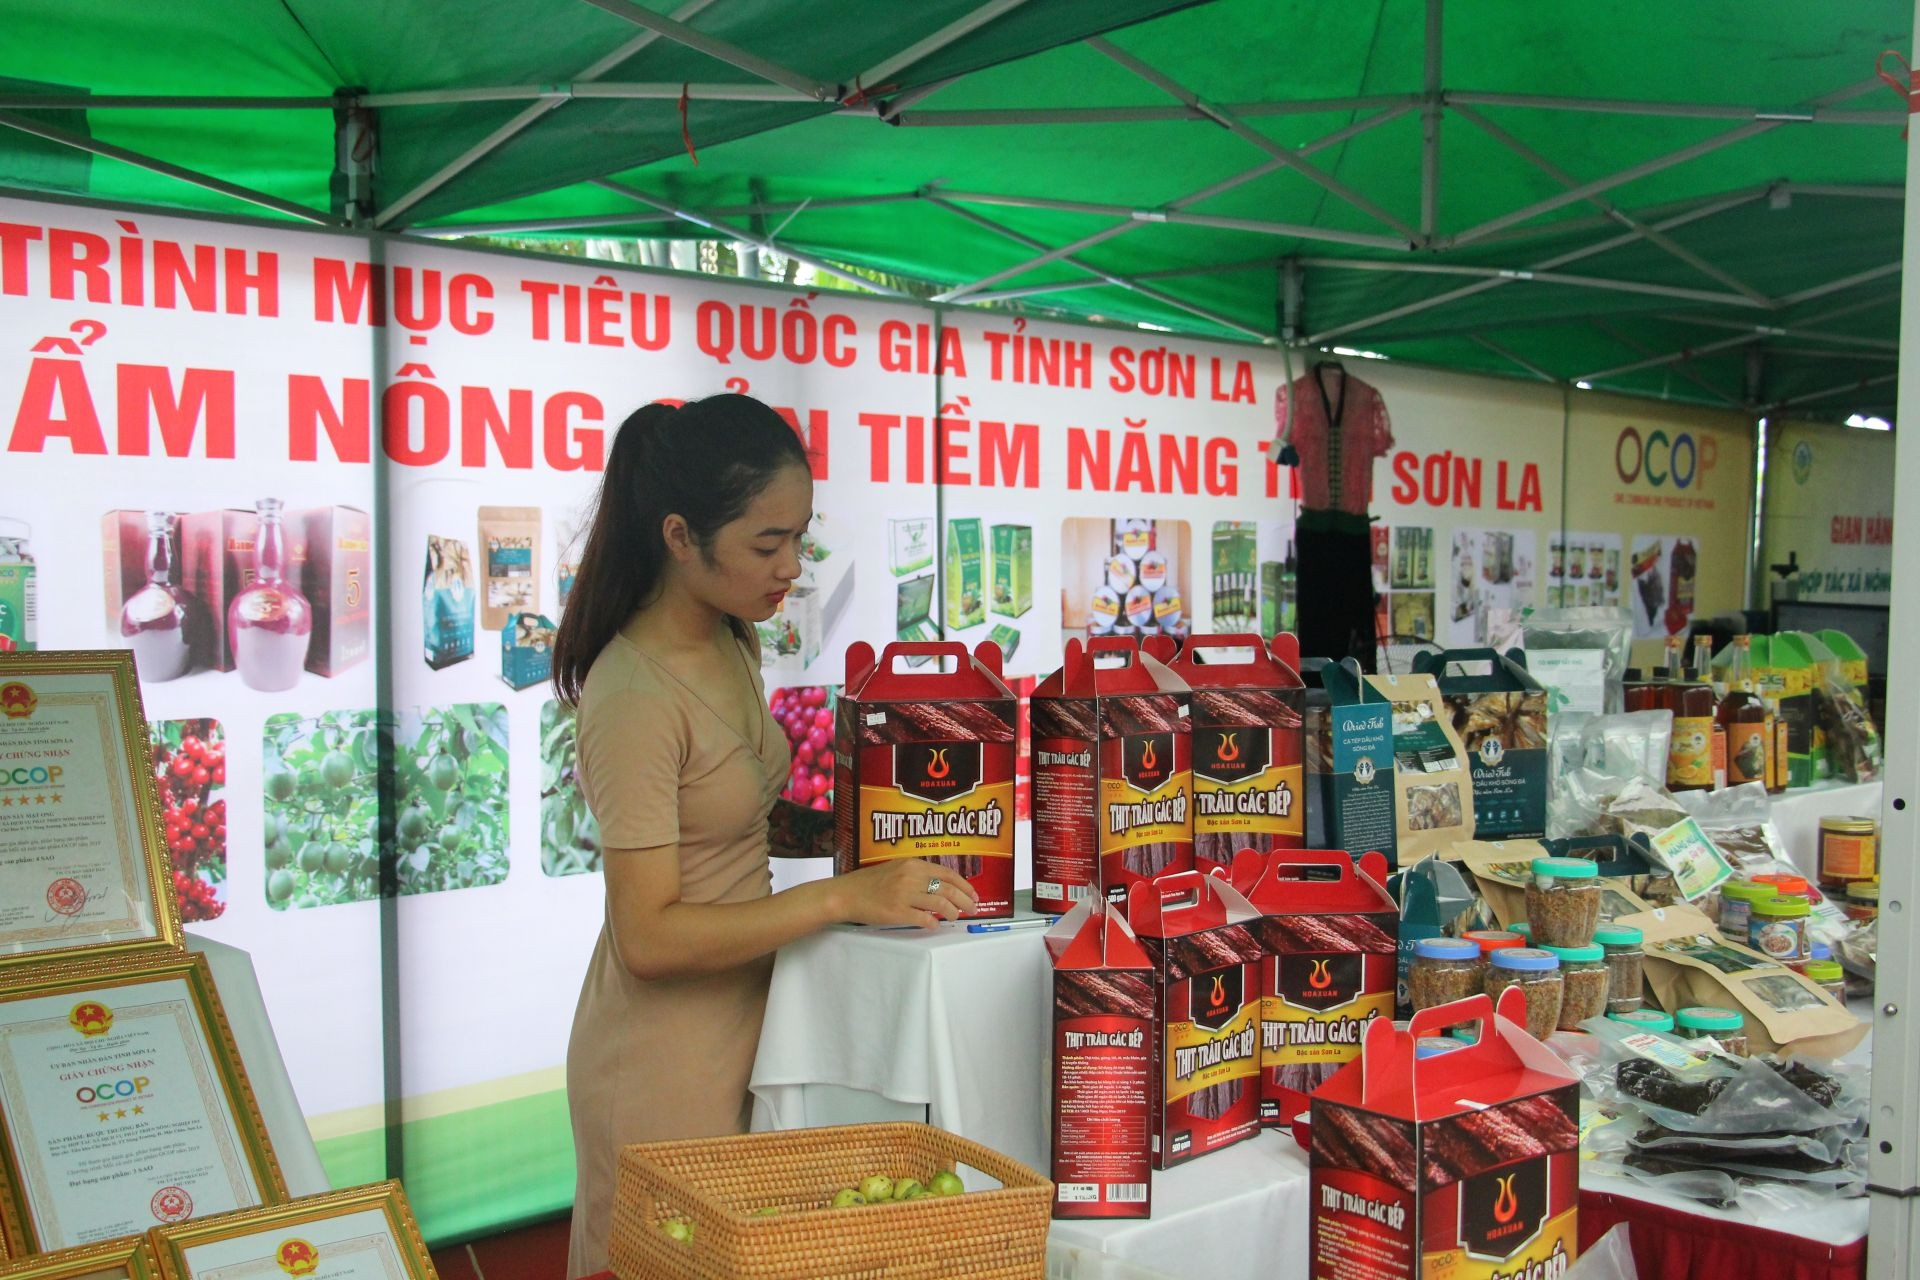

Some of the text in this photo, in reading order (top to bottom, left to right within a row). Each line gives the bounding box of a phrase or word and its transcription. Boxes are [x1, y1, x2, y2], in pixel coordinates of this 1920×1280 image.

[0, 219, 1258, 404] TRÌNH MỤC TIÊU QUỐC GIA TỈNH SƠN LA
[287, 362, 605, 472] NÔNG
[858, 396, 1040, 489] TIỀM
[1066, 417, 1238, 497] NĂNG
[1391, 448, 1491, 509] SƠN
[1497, 460, 1544, 512] LA
[1616, 426, 1718, 491] OCOP
[872, 799, 1002, 845] THỊT TRÂU GÁC BẾP
[1109, 788, 1186, 835] THỊT TRÂU GÁC BẾP
[1199, 781, 1292, 816] TRÂU GÁC BẾP
[1065, 1026, 1144, 1050] THỊT TRÂU GÁC BẾP
[1175, 1020, 1255, 1079] THỊT TRÂU GÁC BẾP
[1289, 1018, 1325, 1044] TRÂU
[1328, 1016, 1357, 1043] GÁC
[76, 1076, 150, 1104] OCOP
[1321, 1183, 1405, 1231] THỊT TRÂU GÁC BẾP
